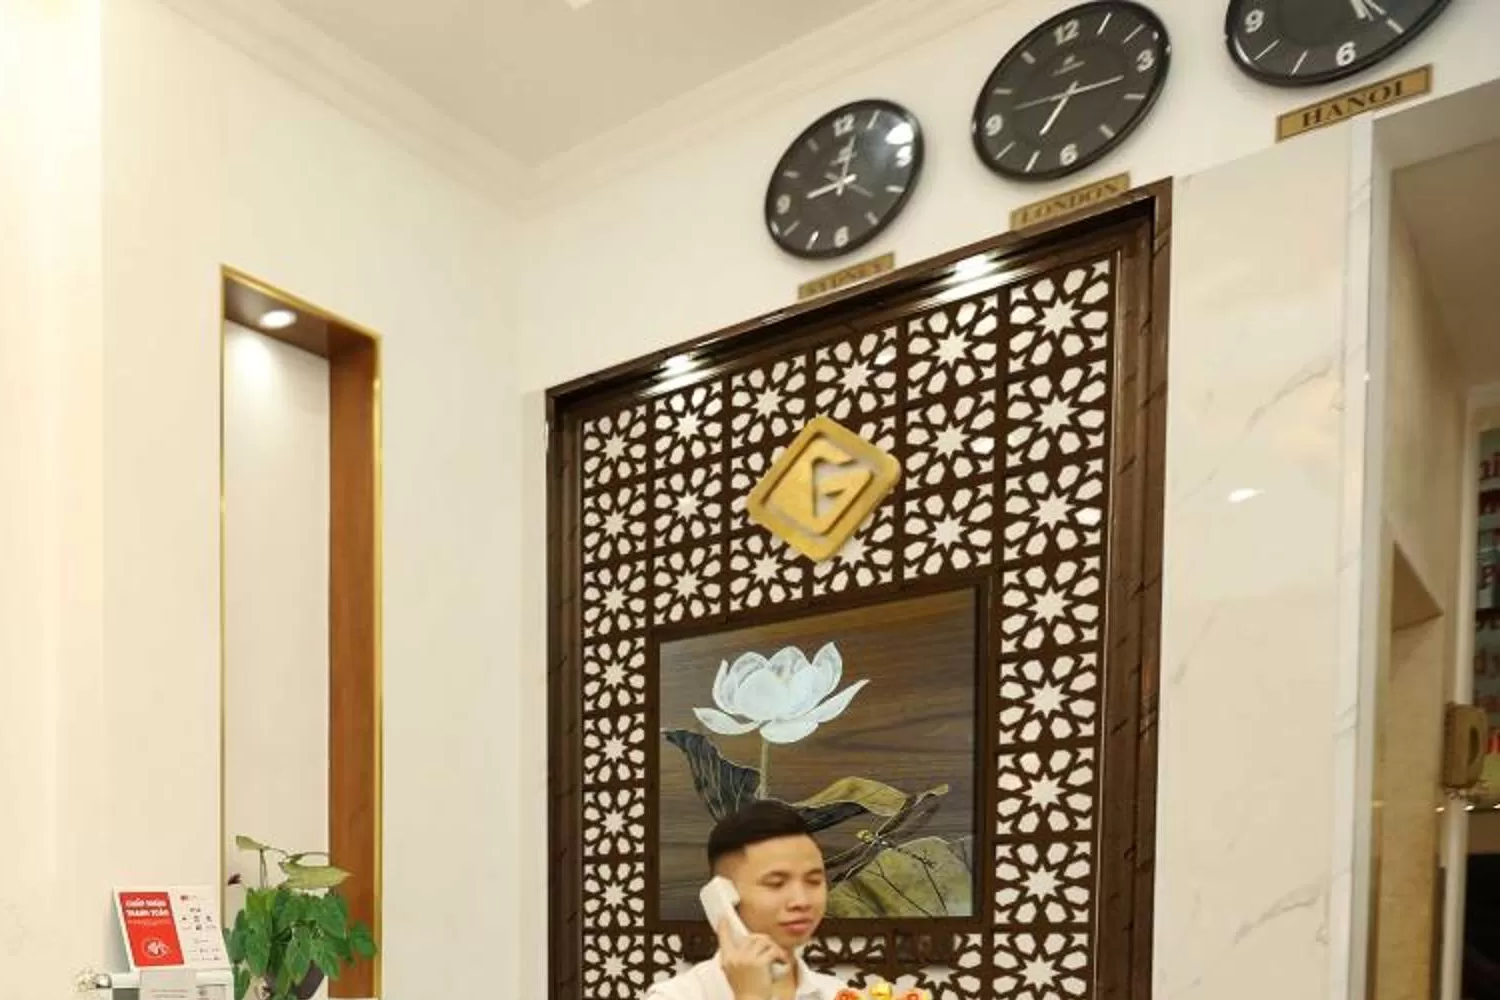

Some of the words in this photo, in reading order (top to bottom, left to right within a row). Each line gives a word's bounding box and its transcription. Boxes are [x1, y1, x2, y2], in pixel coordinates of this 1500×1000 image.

[1053, 19, 1082, 46] 12
[1244, 9, 1265, 33] 9
[1136, 47, 1155, 72] 3
[1335, 41, 1356, 66] 6
[1301, 80, 1405, 129] HANOI
[833, 115, 855, 135] 12
[986, 115, 1003, 135] 9
[1059, 144, 1078, 165] 6
[775, 194, 791, 214] 9
[833, 226, 849, 248] 6
